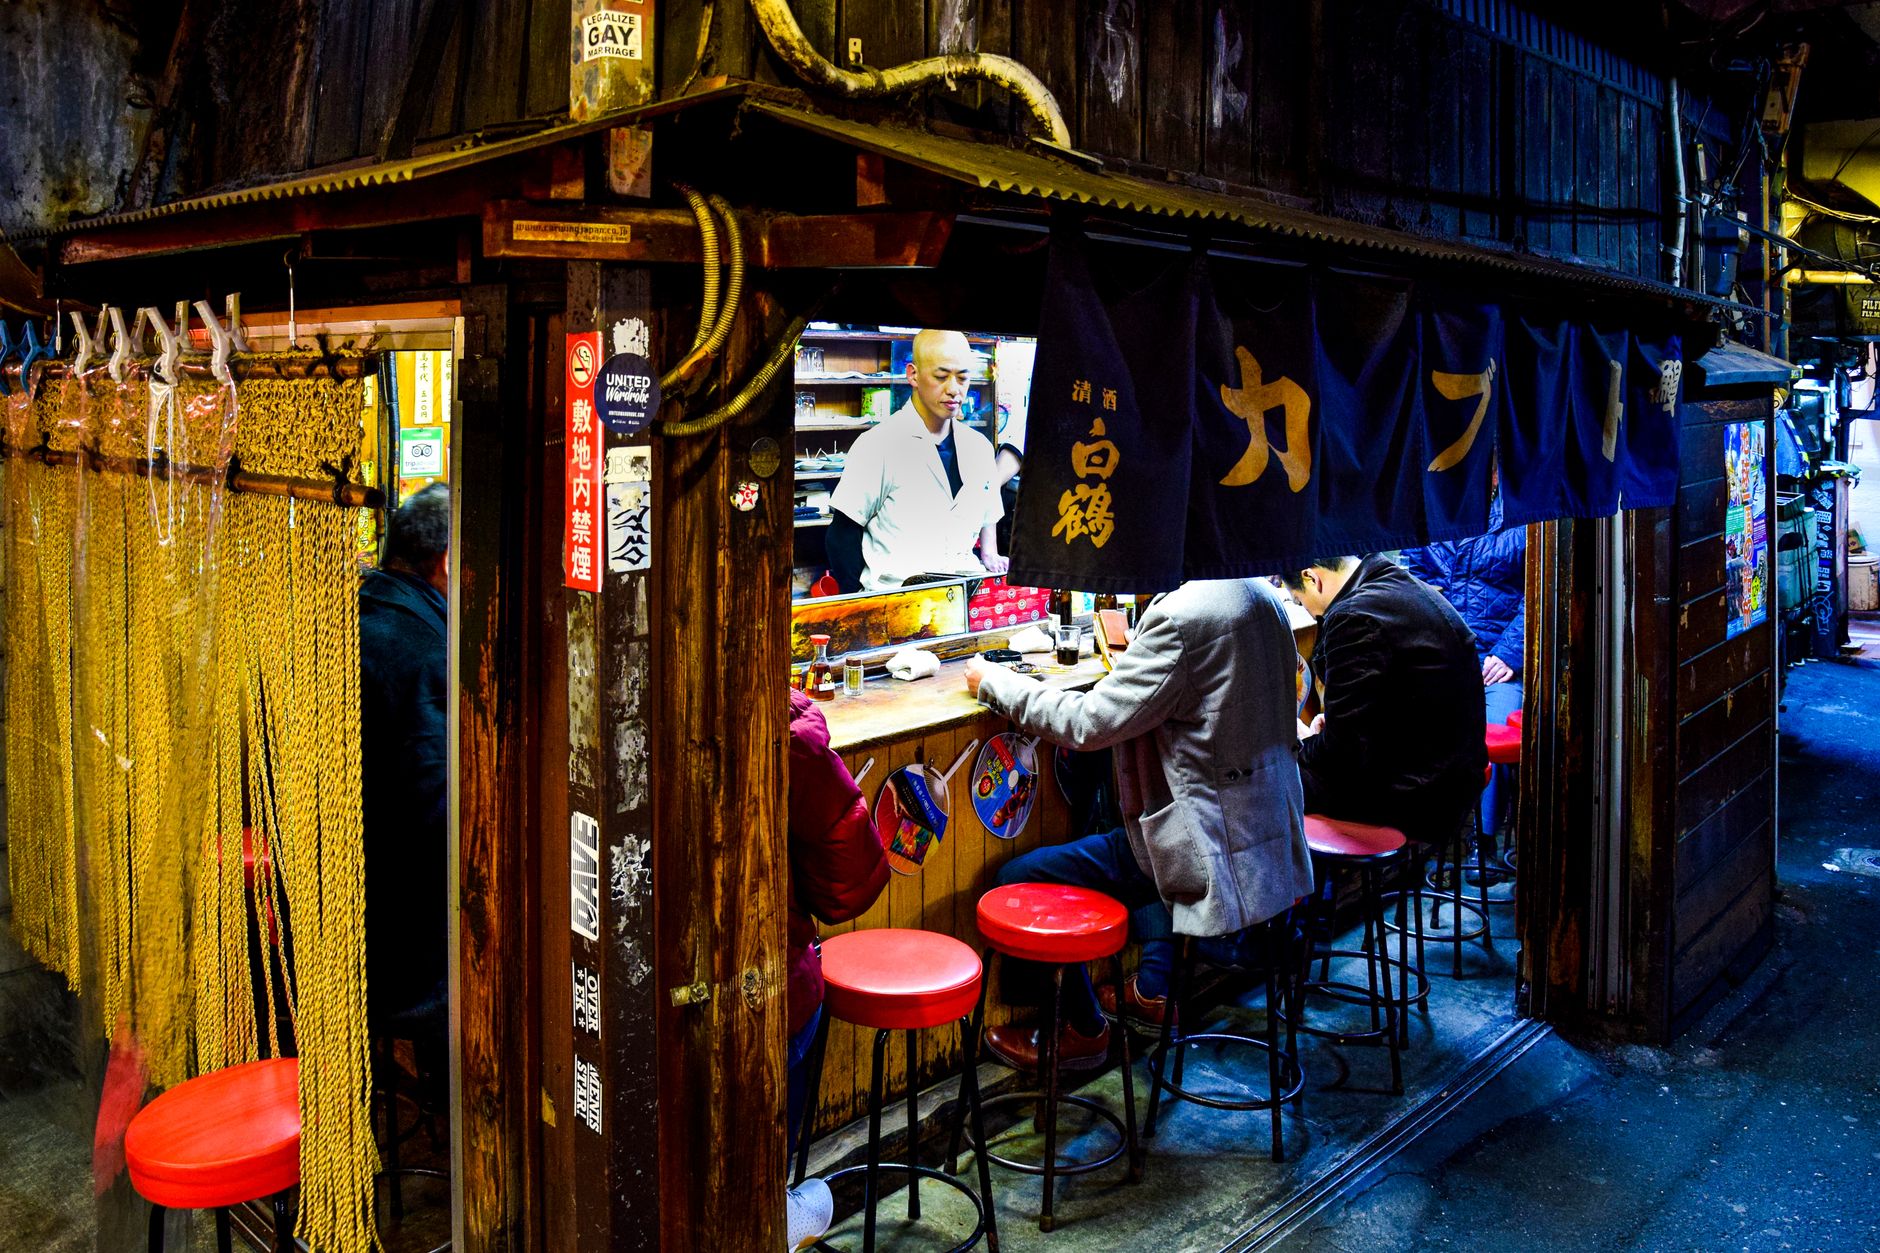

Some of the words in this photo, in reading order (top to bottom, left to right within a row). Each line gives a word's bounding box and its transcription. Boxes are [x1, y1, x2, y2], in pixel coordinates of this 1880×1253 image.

[587, 13, 635, 25] LEGALIZE
[588, 24, 634, 46] GAY
[588, 46, 635, 57] MARRIAGE
[606, 373, 651, 388] UNITED
[1072, 379, 1118, 412] 清酒
[605, 385, 650, 409] Wardrobe
[571, 398, 593, 582] 敷地内禁煙
[1051, 416, 1120, 549] 白鶴
[572, 814, 598, 937] DAVE
[575, 982, 586, 1014] EK
[587, 975, 599, 1032] OVER
[577, 1060, 587, 1119] STAR!
